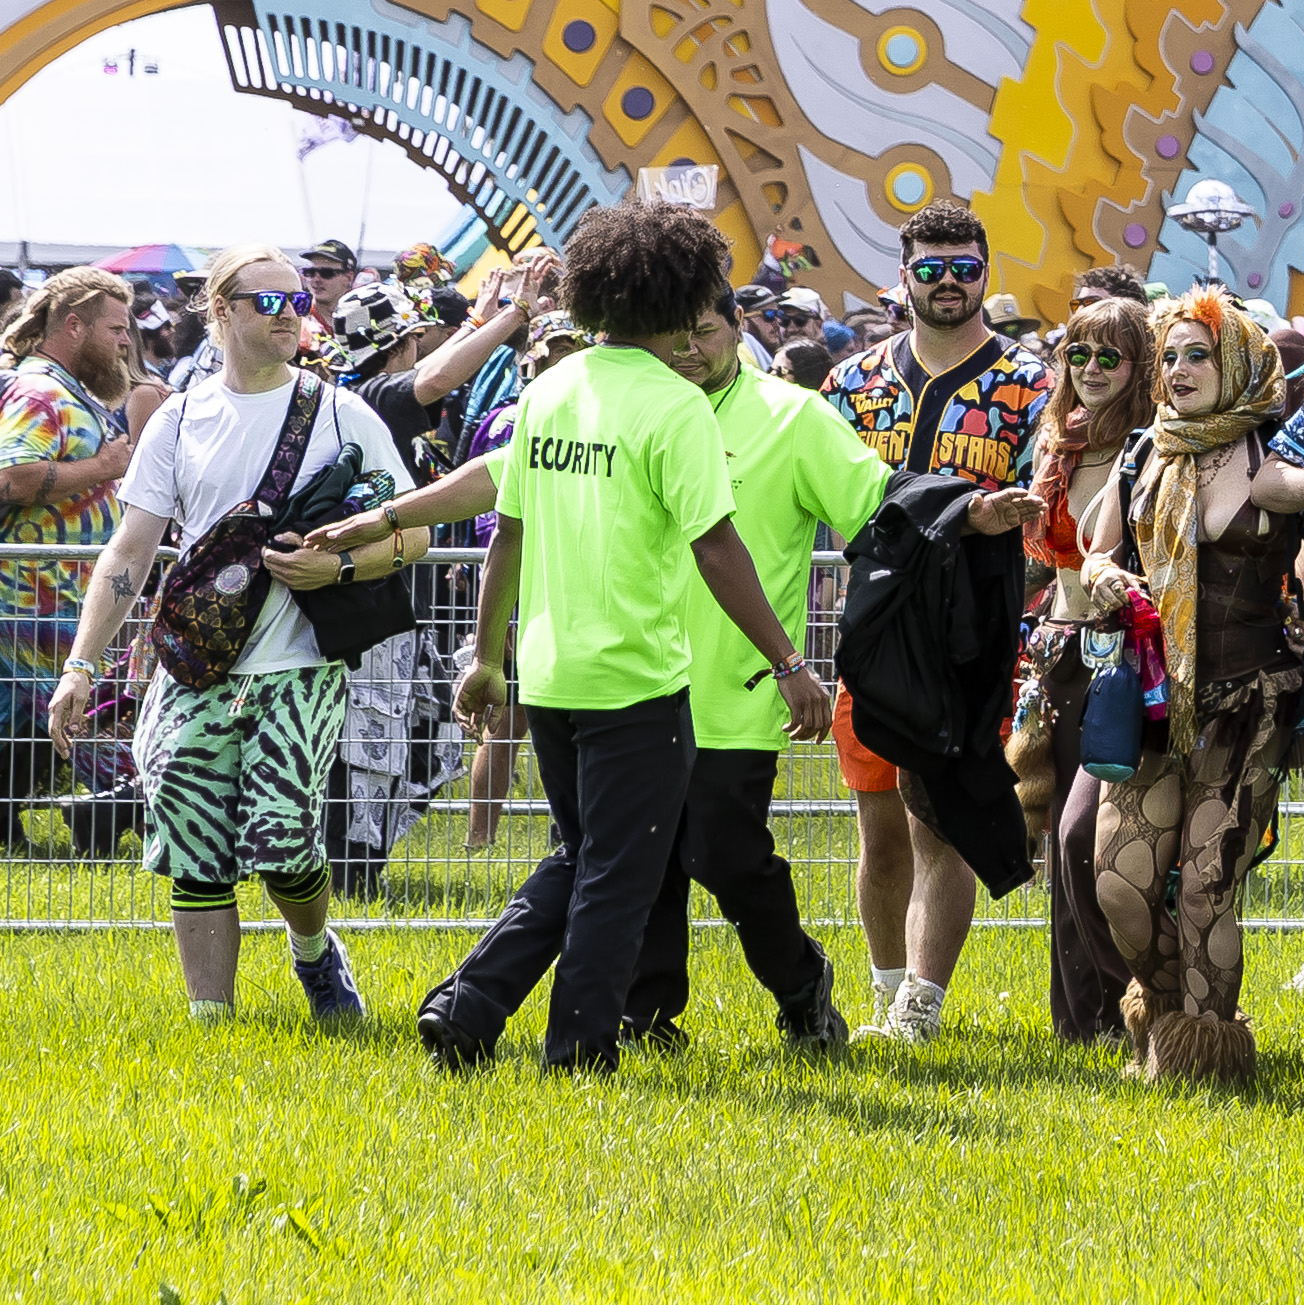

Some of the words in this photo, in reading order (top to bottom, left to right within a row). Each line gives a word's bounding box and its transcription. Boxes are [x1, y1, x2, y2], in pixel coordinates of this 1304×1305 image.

[855, 398, 894, 413] VALLEY
[527, 436, 617, 477] ECURITY
[858, 430, 906, 461] VEN
[938, 432, 1011, 481] STARS
